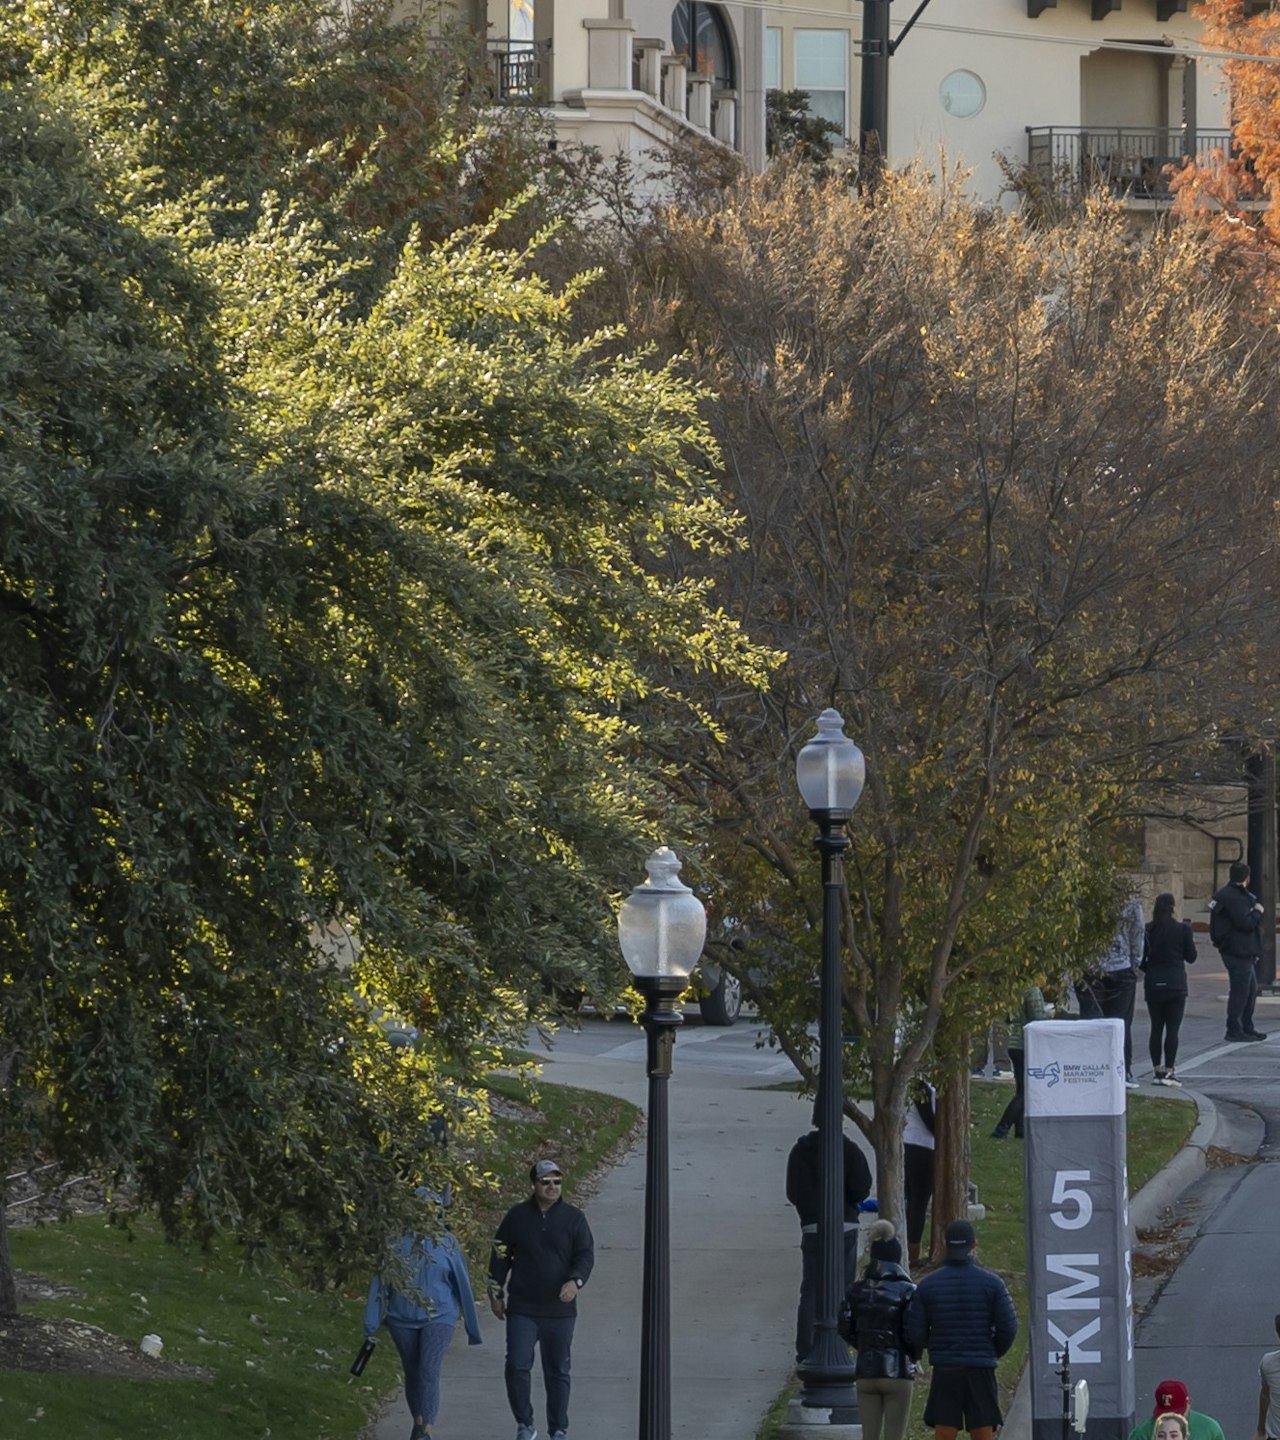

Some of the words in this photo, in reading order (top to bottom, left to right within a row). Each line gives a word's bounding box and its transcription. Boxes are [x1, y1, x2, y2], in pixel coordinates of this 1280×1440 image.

[1049, 1169, 1094, 1231] 5
[1046, 1252, 1102, 1365] KM
[1162, 1394, 1173, 1406] T
